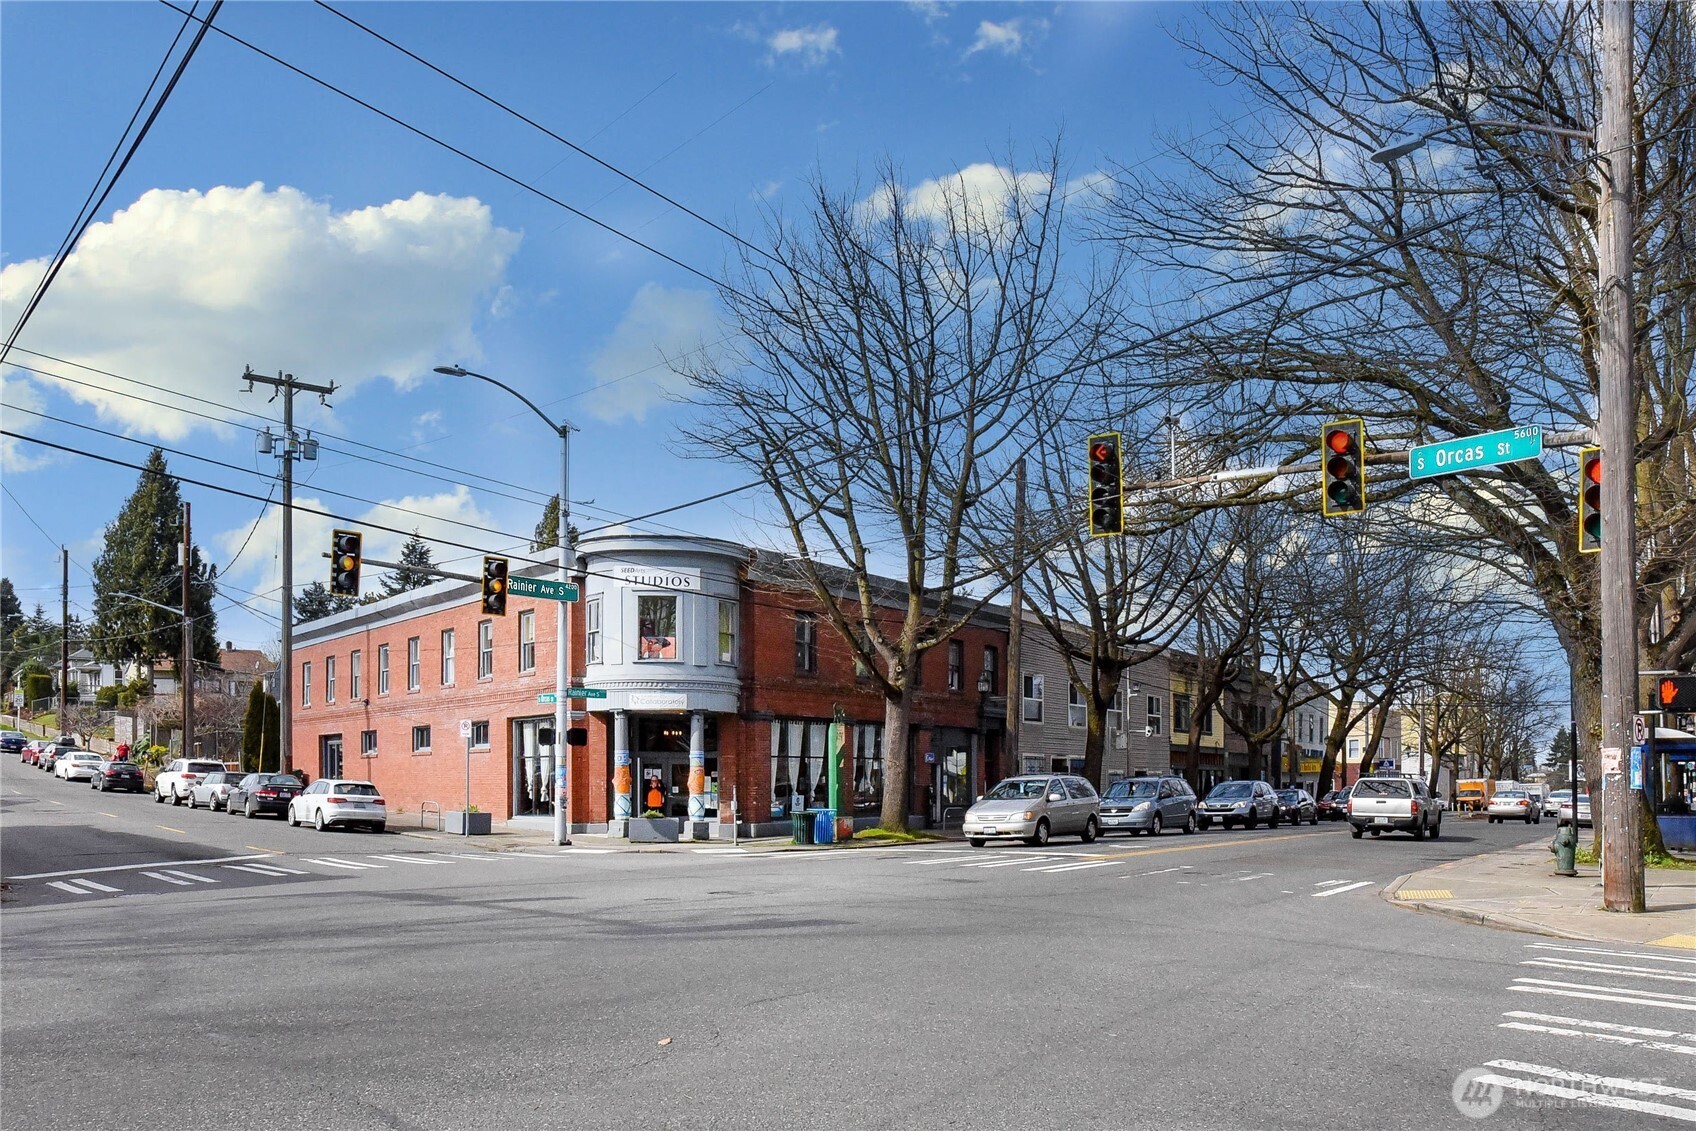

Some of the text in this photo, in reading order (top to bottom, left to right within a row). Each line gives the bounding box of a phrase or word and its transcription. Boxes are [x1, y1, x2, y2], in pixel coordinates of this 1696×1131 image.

[1514, 426, 1538, 439] 5600
[1417, 442, 1511, 470] S Orcas St
[508, 578, 564, 596] Rainier Ave S
[625, 575, 690, 587] STUDIOS
[568, 689, 587, 697] Rainier
